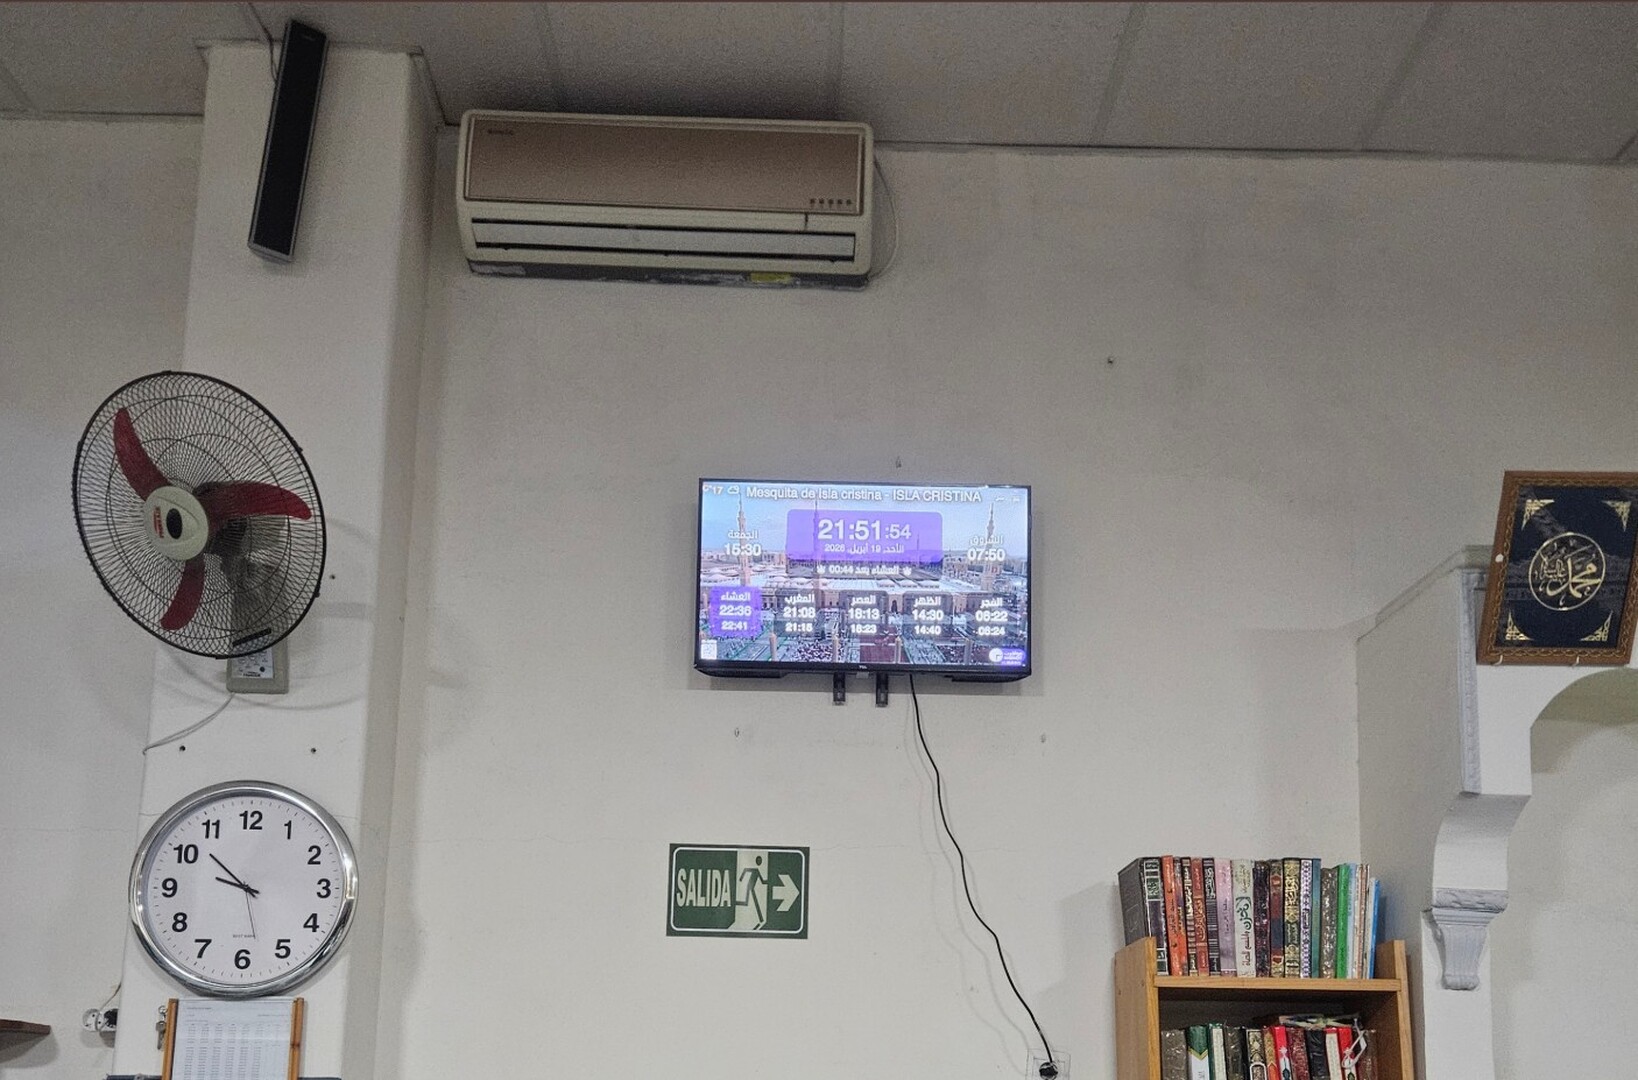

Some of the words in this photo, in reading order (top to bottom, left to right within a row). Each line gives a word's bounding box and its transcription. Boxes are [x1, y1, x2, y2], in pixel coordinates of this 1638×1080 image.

[746, 487, 798, 500] Mesquita
[801, 488, 816, 499] de
[818, 488, 838, 500] Isla
[841, 489, 882, 501] cristina
[893, 490, 919, 501] ISLA
[922, 490, 982, 502] CRISTINA
[724, 543, 762, 556] 15:30
[967, 548, 1006, 562] 07:50
[720, 591, 751, 601] العشاء
[784, 593, 815, 605] المغرب
[850, 594, 877, 606] العصر
[913, 595, 941, 608] الظهر
[980, 597, 1003, 609] الفجر
[783, 606, 816, 619] 21:08
[912, 608, 944, 621] 14:30
[202, 819, 220, 839] 11
[239, 810, 263, 830] 12
[284, 820, 292, 840] 1
[173, 844, 199, 864] 10
[307, 844, 322, 865] 2
[161, 877, 178, 898] 9
[316, 878, 331, 899] 3
[676, 868, 731, 907] SALIDA
[171, 912, 188, 933] 8
[303, 913, 319, 933] 4
[194, 938, 212, 958] 7
[274, 938, 291, 959] 5
[234, 949, 251, 970] 6
